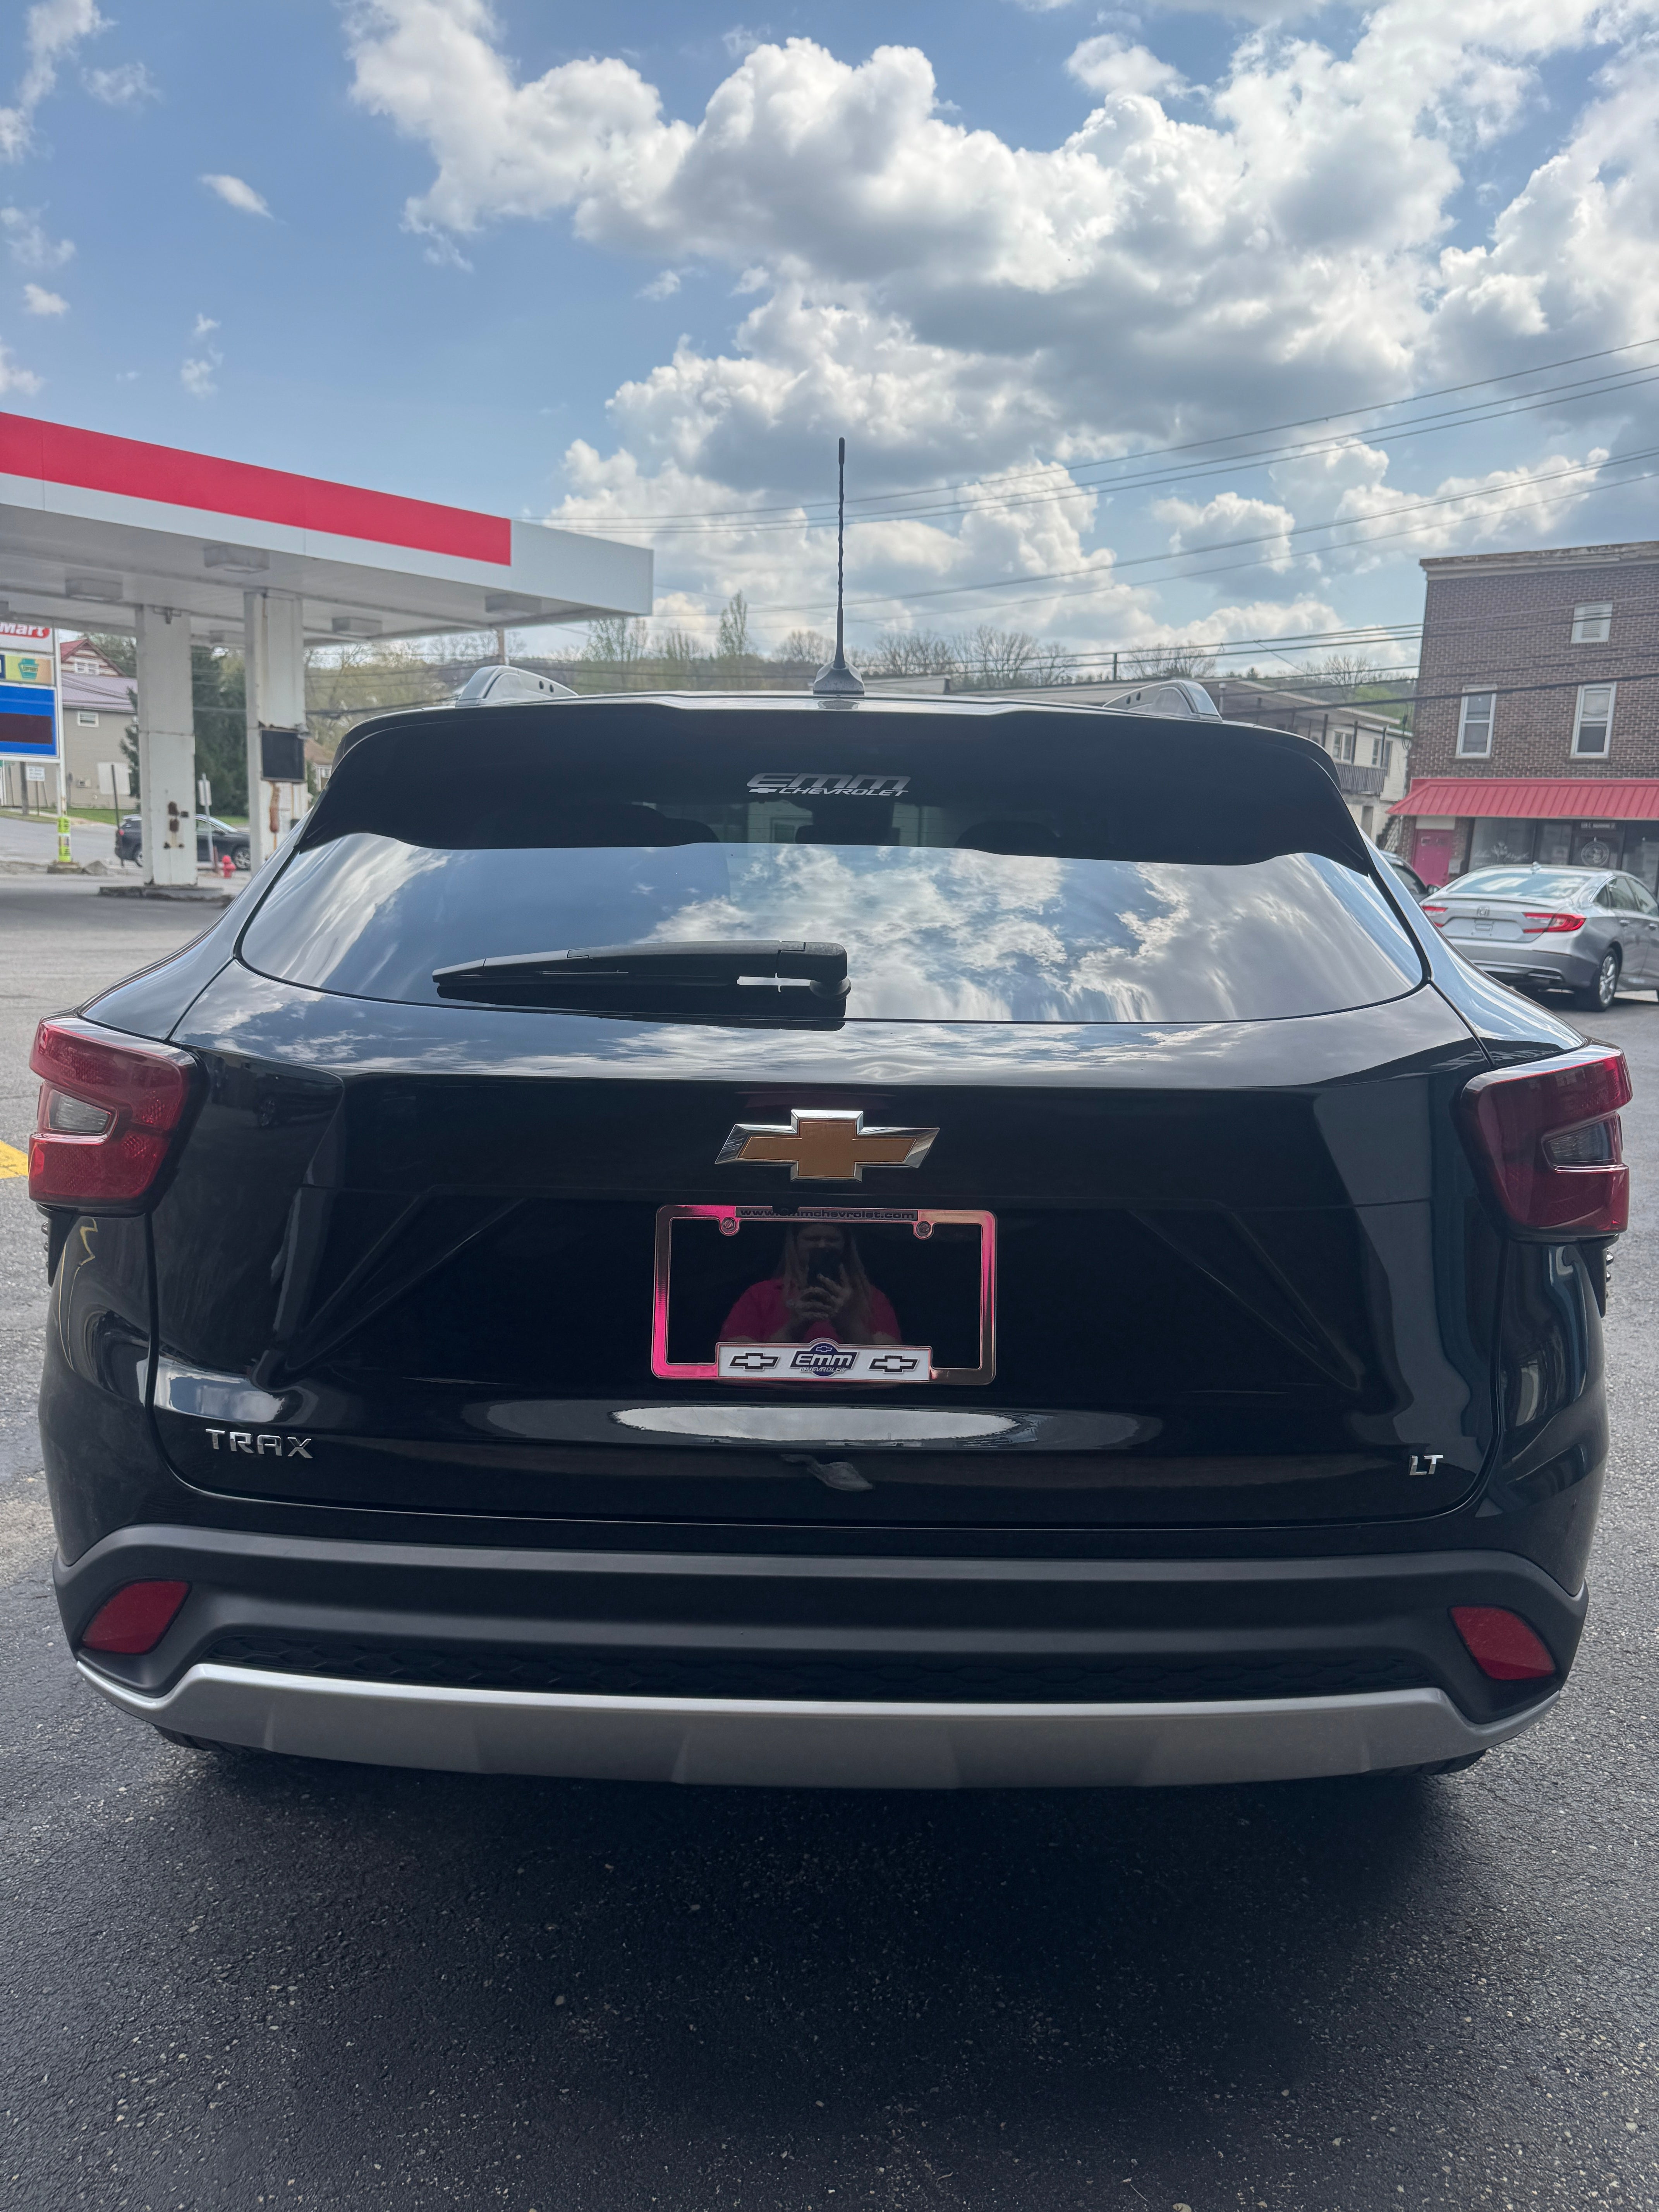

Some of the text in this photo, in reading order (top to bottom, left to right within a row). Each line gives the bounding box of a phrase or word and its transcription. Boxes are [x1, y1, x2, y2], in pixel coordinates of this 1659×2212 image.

[778, 787, 909, 797] CHEVROLET
[740, 1209, 914, 1219] www.mmchevrolet.com
[205, 1428, 313, 1459] TRAX
[1409, 1455, 1443, 1476] LT
